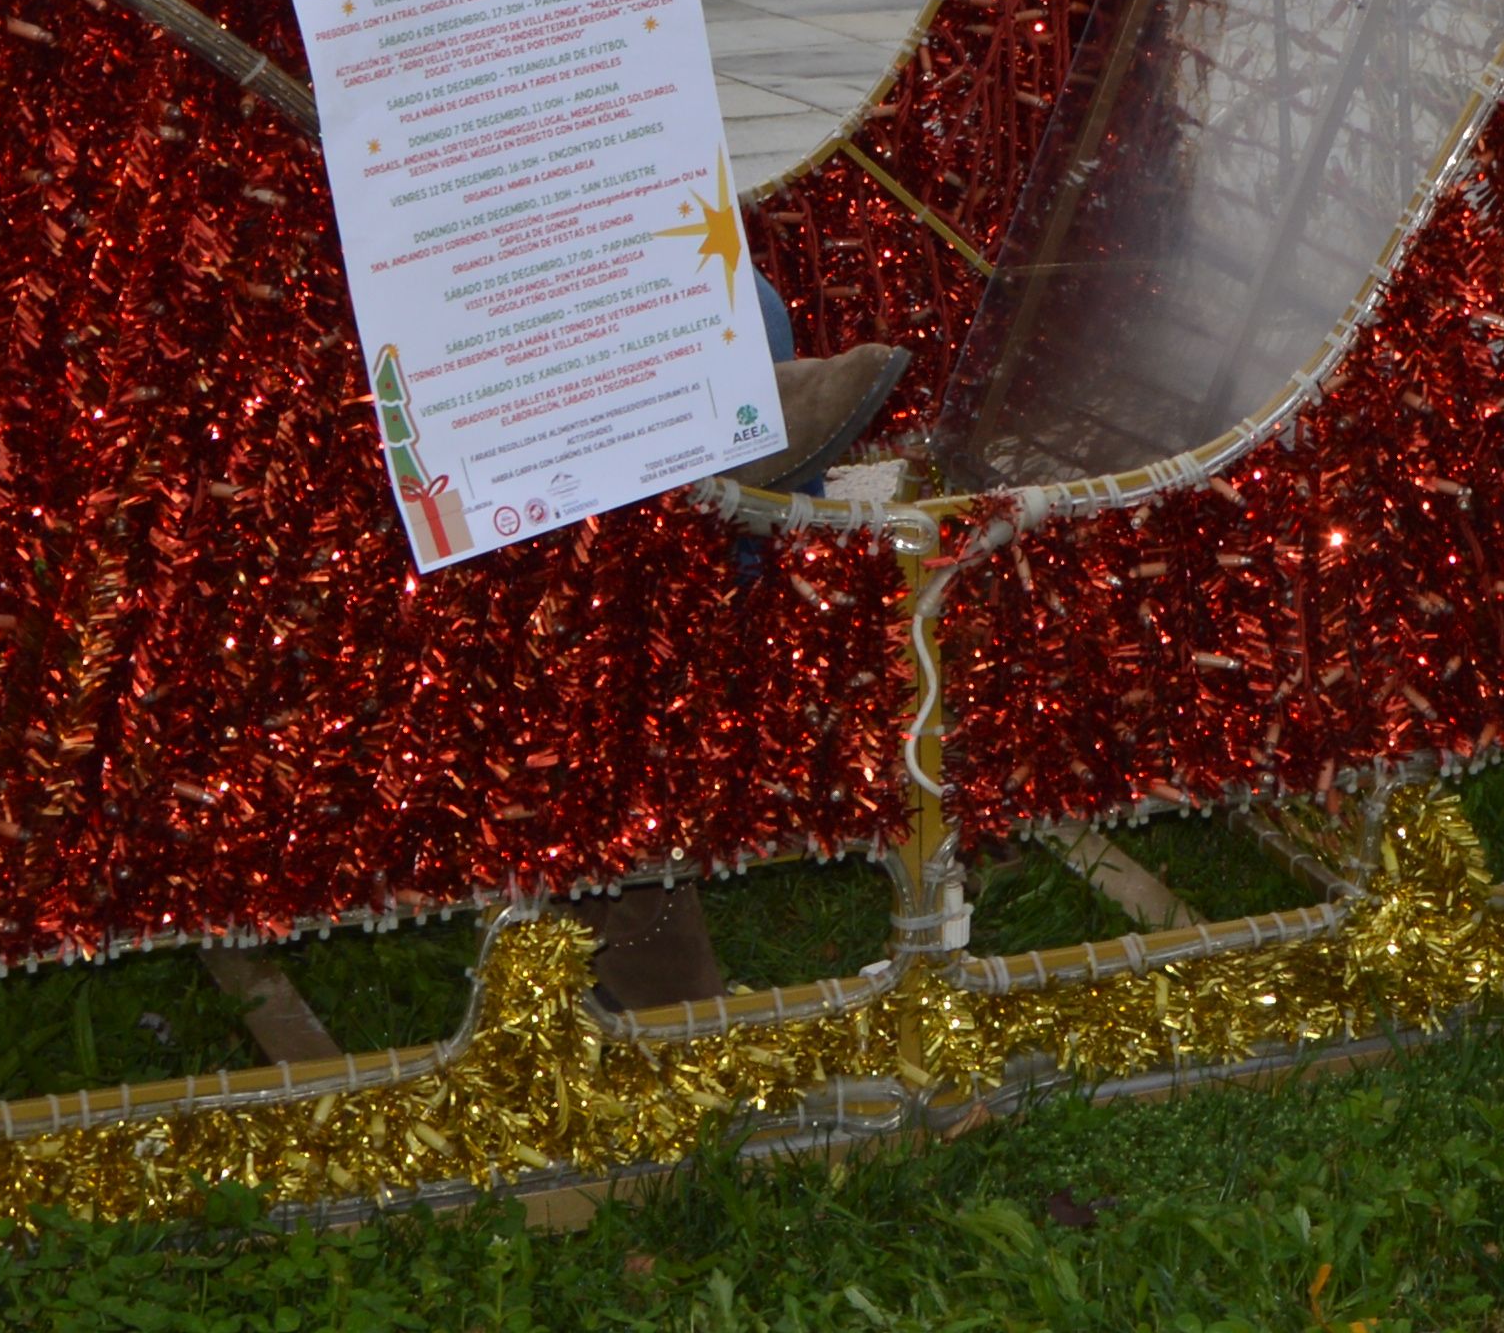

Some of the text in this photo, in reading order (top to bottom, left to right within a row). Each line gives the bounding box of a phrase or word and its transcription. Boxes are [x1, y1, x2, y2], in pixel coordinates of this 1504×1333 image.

[422, 23, 435, 38] DE
[431, 84, 445, 99] DE
[572, 47, 587, 62] DE
[445, 99, 457, 113] DE
[496, 87, 503, 99] E
[558, 69, 571, 81] DE
[460, 119, 475, 134] DE
[439, 179, 453, 194] DE
[602, 133, 616, 148] DE
[471, 212, 485, 227] DE
[495, 271, 510, 287] DE
[497, 324, 511, 339] DE
[619, 287, 634, 302] DE
[732, 423, 769, 445] AEEA
